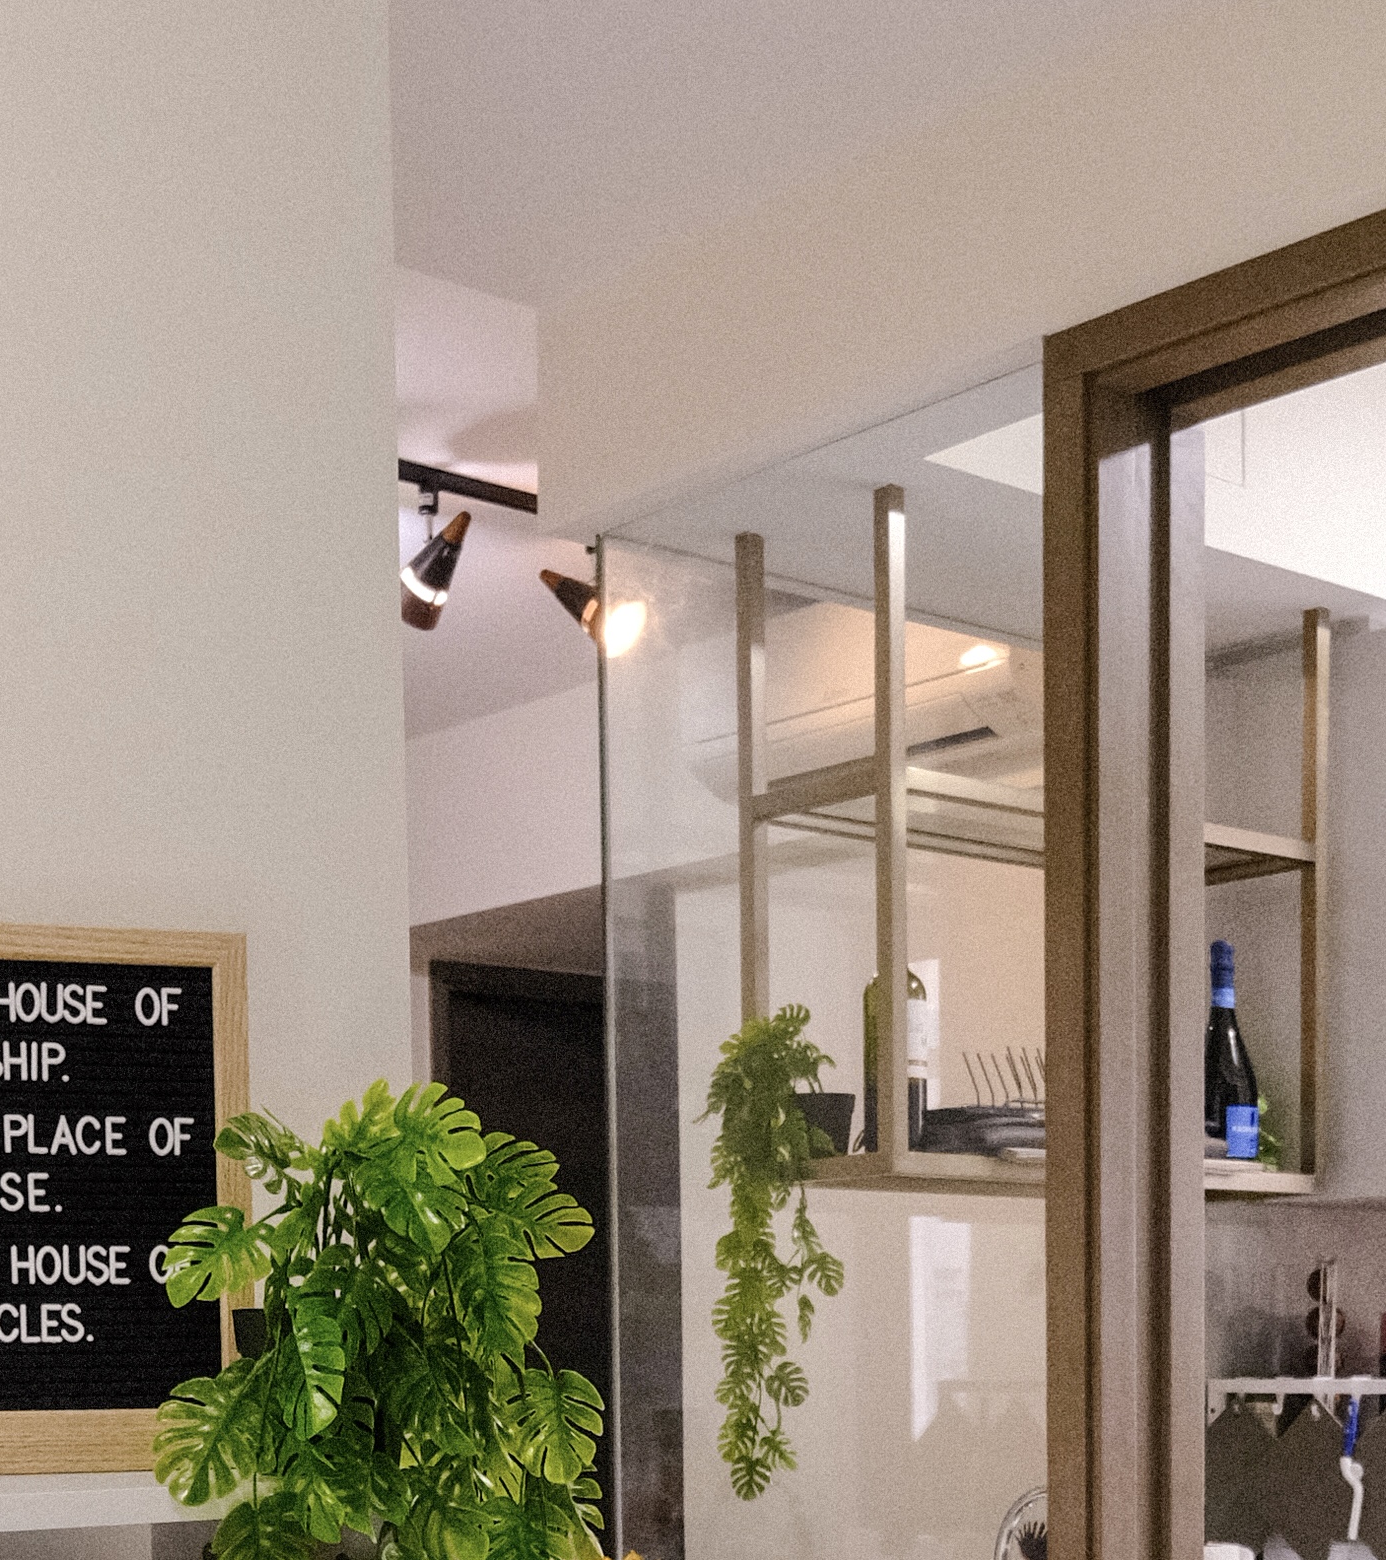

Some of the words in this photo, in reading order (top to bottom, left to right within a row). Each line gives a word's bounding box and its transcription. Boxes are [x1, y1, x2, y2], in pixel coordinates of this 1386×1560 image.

[134, 987, 182, 1026] OF
[3, 1114, 127, 1156] PLACE
[148, 1117, 195, 1156] OF
[10, 1245, 132, 1286] HOUSE
[148, 1244, 192, 1286] O
